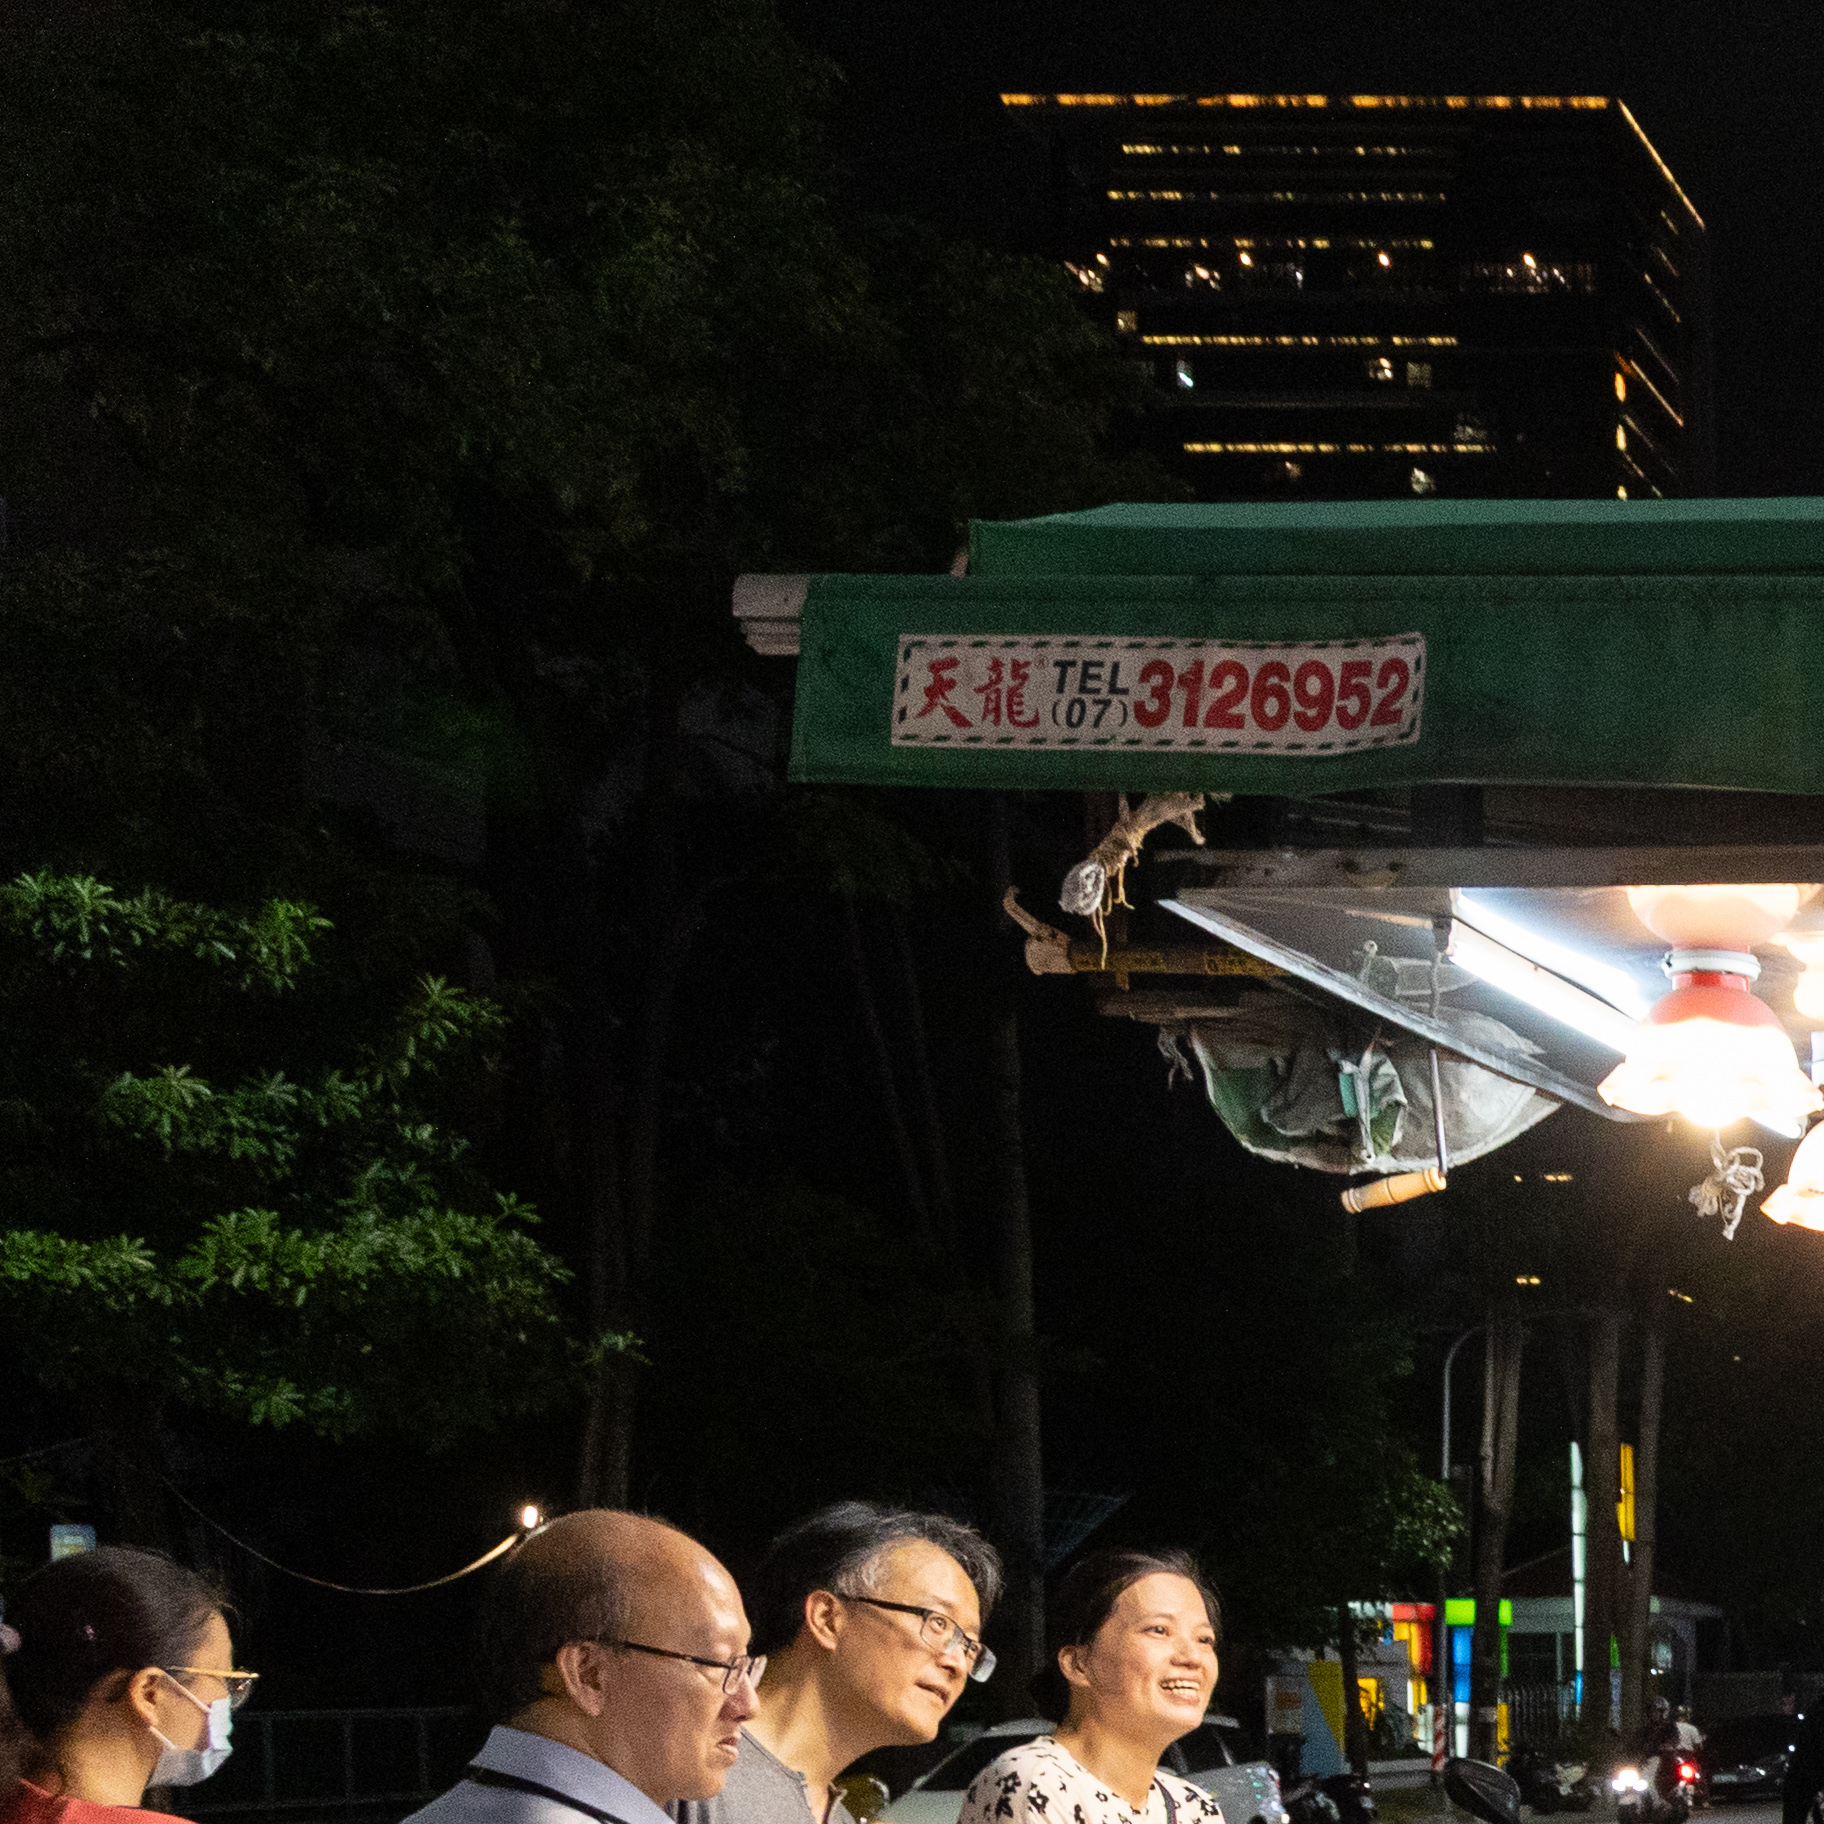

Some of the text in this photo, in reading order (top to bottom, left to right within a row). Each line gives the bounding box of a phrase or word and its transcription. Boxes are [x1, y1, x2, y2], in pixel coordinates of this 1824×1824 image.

[916, 656, 1039, 728] 天龍
[1053, 660, 1129, 695] TEL
[1132, 659, 1410, 731] 3126952
[1052, 699, 1128, 730] (07)
